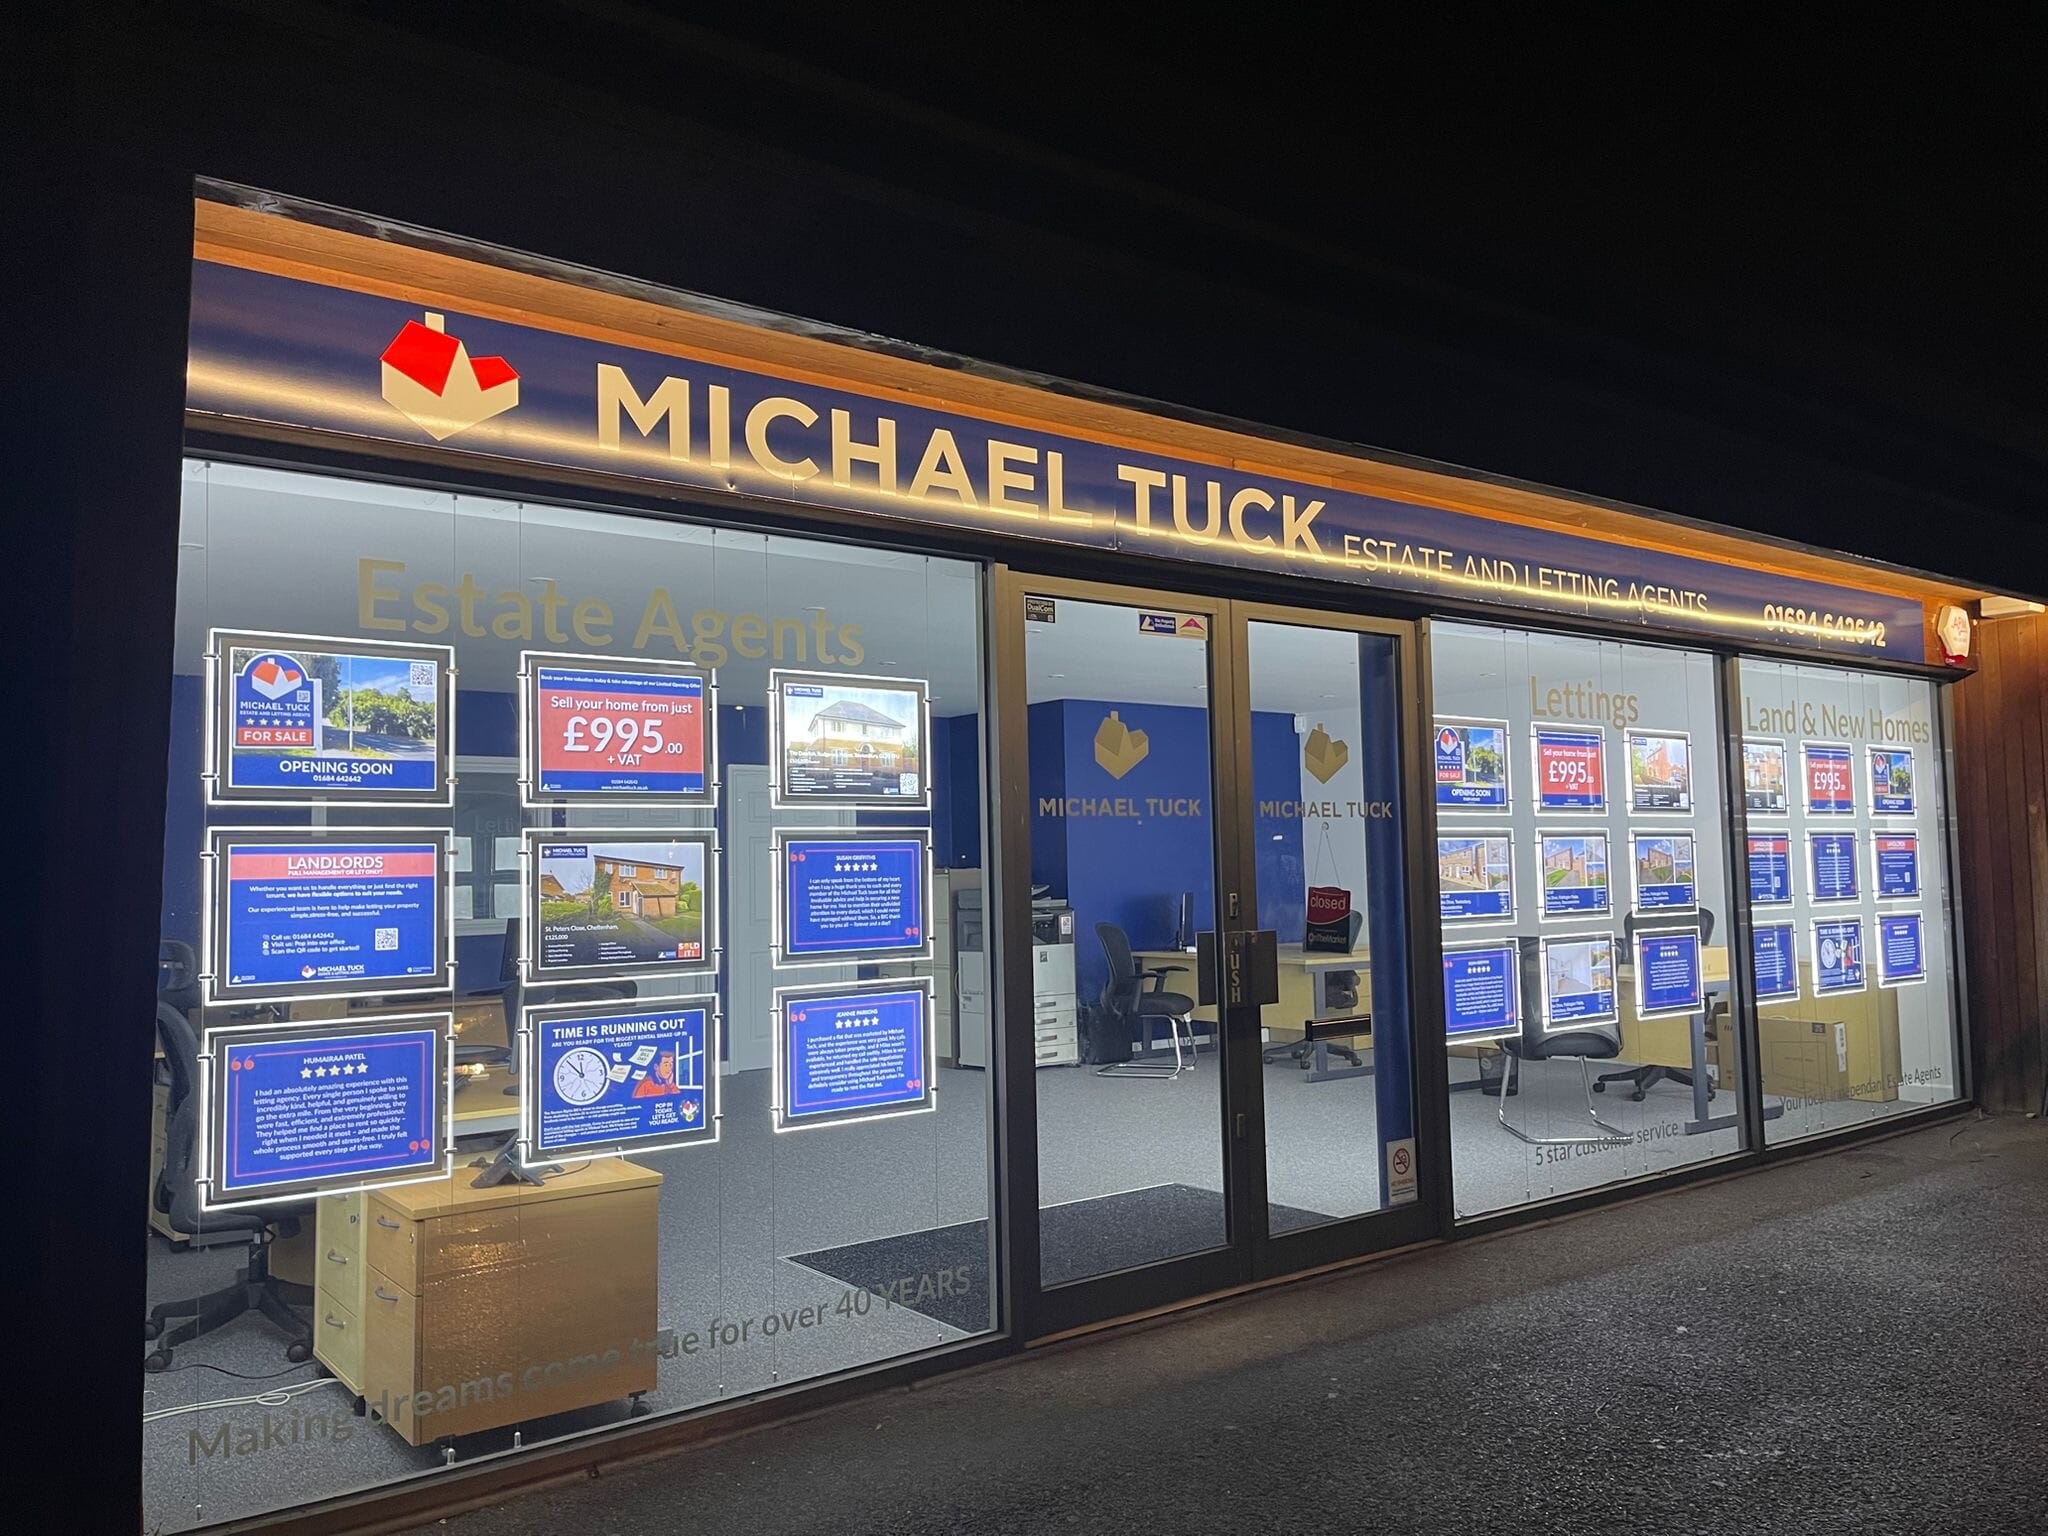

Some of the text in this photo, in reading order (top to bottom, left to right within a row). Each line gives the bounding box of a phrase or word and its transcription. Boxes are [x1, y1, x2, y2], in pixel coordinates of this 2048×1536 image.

[597, 362, 1328, 564] MICHAEL TUCK
[1343, 534, 1708, 616] ESTATE AND LETTING AGENTS
[357, 556, 866, 670] Estate Agents
[1763, 604, 1886, 648] 01684 642642
[240, 701, 310, 711] MICHAEL TUCK
[551, 696, 692, 715] Sell your home from just
[1530, 675, 1639, 731] Lettings
[1746, 696, 1930, 745] Land & New Homes
[244, 731, 307, 741] FOR SALE
[280, 760, 392, 775] OPENING SOON
[617, 754, 642, 766] VAT
[1039, 798, 1202, 817] MICHAEL TUCK
[1260, 800, 1393, 819] MICHAEL TUCK
[288, 856, 383, 869] LANDLORDS
[1310, 895, 1346, 910] closed
[553, 1018, 685, 1039] TIME IS RUNNING OUT
[304, 1053, 366, 1064] HUMAIRAA PATEL
[1779, 1095, 1804, 1112] Your
[1887, 1073, 1913, 1089] Esate
[1914, 1066, 1942, 1085] Agents
[1535, 1146, 1544, 1166] 5
[1547, 1144, 1573, 1164] star
[1636, 1120, 1679, 1144] service
[188, 1406, 353, 1466] Making
[366, 1371, 513, 1427] dreams
[708, 1317, 754, 1349] for
[762, 1302, 828, 1336] over
[836, 1287, 870, 1319] 40
[878, 1265, 971, 1310] YEARS
